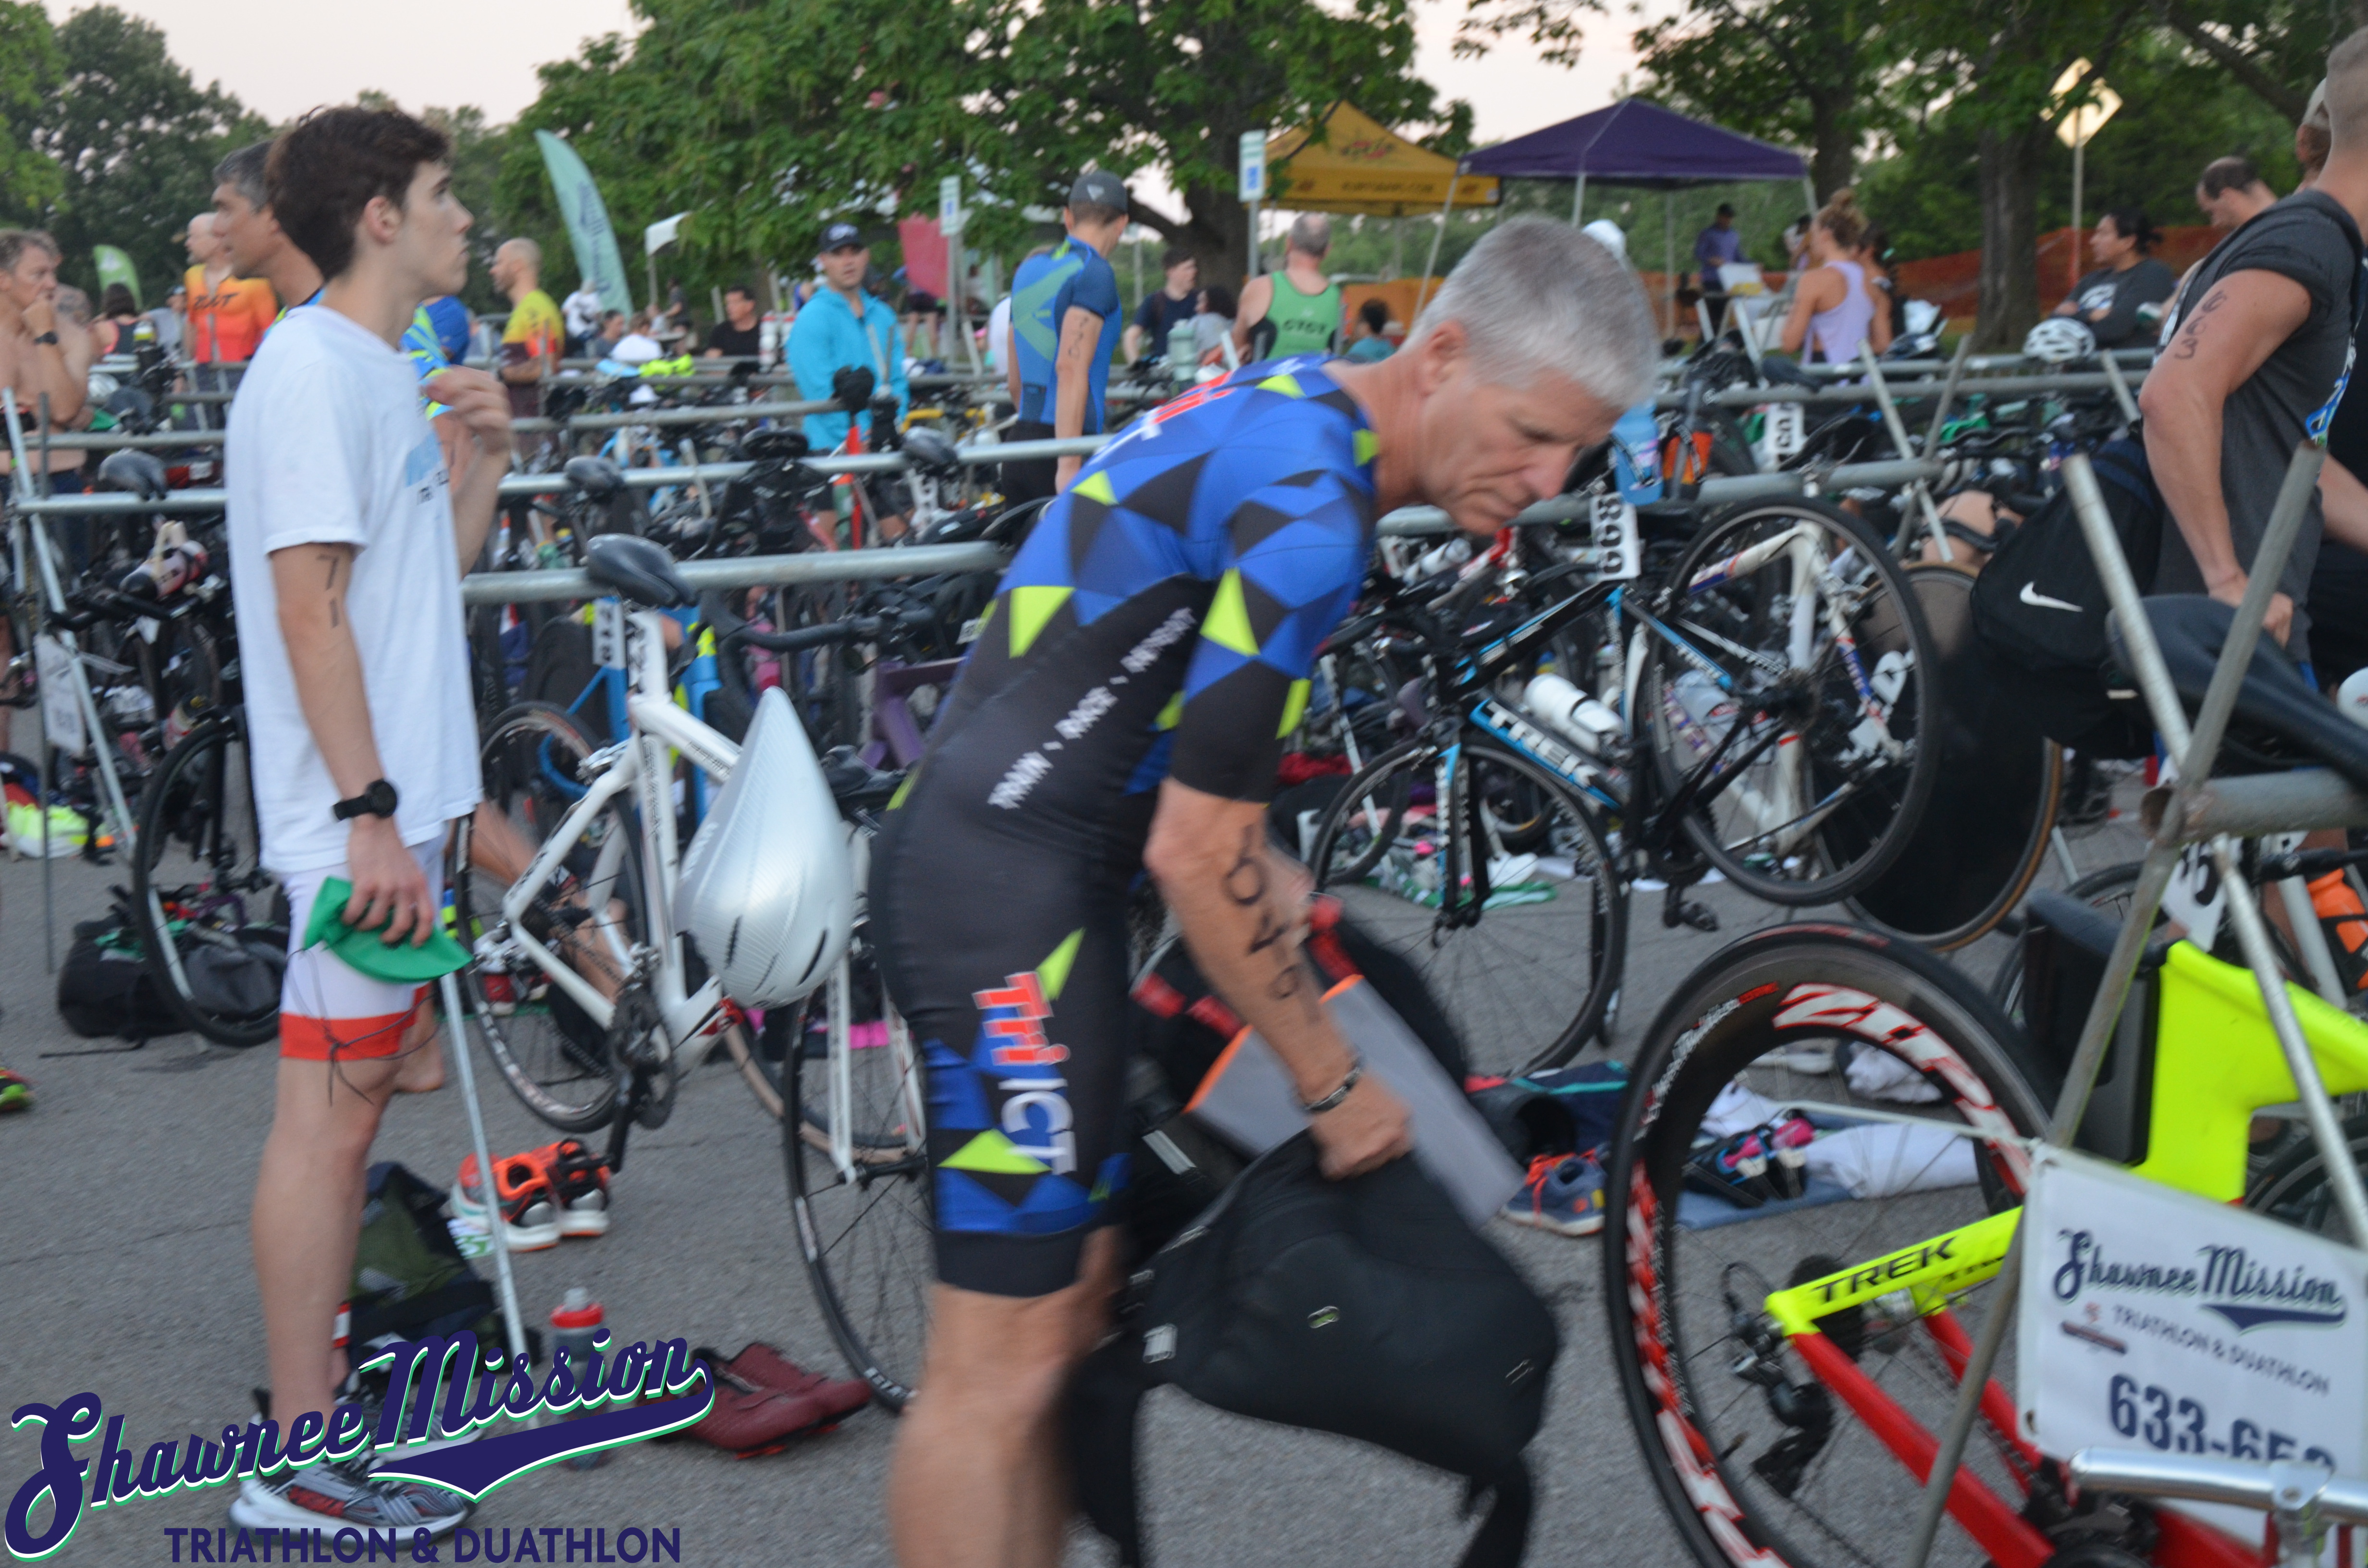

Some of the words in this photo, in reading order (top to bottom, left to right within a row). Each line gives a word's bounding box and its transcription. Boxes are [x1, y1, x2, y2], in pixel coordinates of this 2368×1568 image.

[1487, 701, 1600, 789] TREK
[1810, 1235, 1960, 1303] TREK
[2054, 1229, 2199, 1304] Shawnee
[2197, 1244, 2347, 1311] Mission
[2113, 1303, 2210, 1352] TRIATHLON
[2210, 1338, 2227, 1359] &
[2228, 1345, 2331, 1397] DUATHLON
